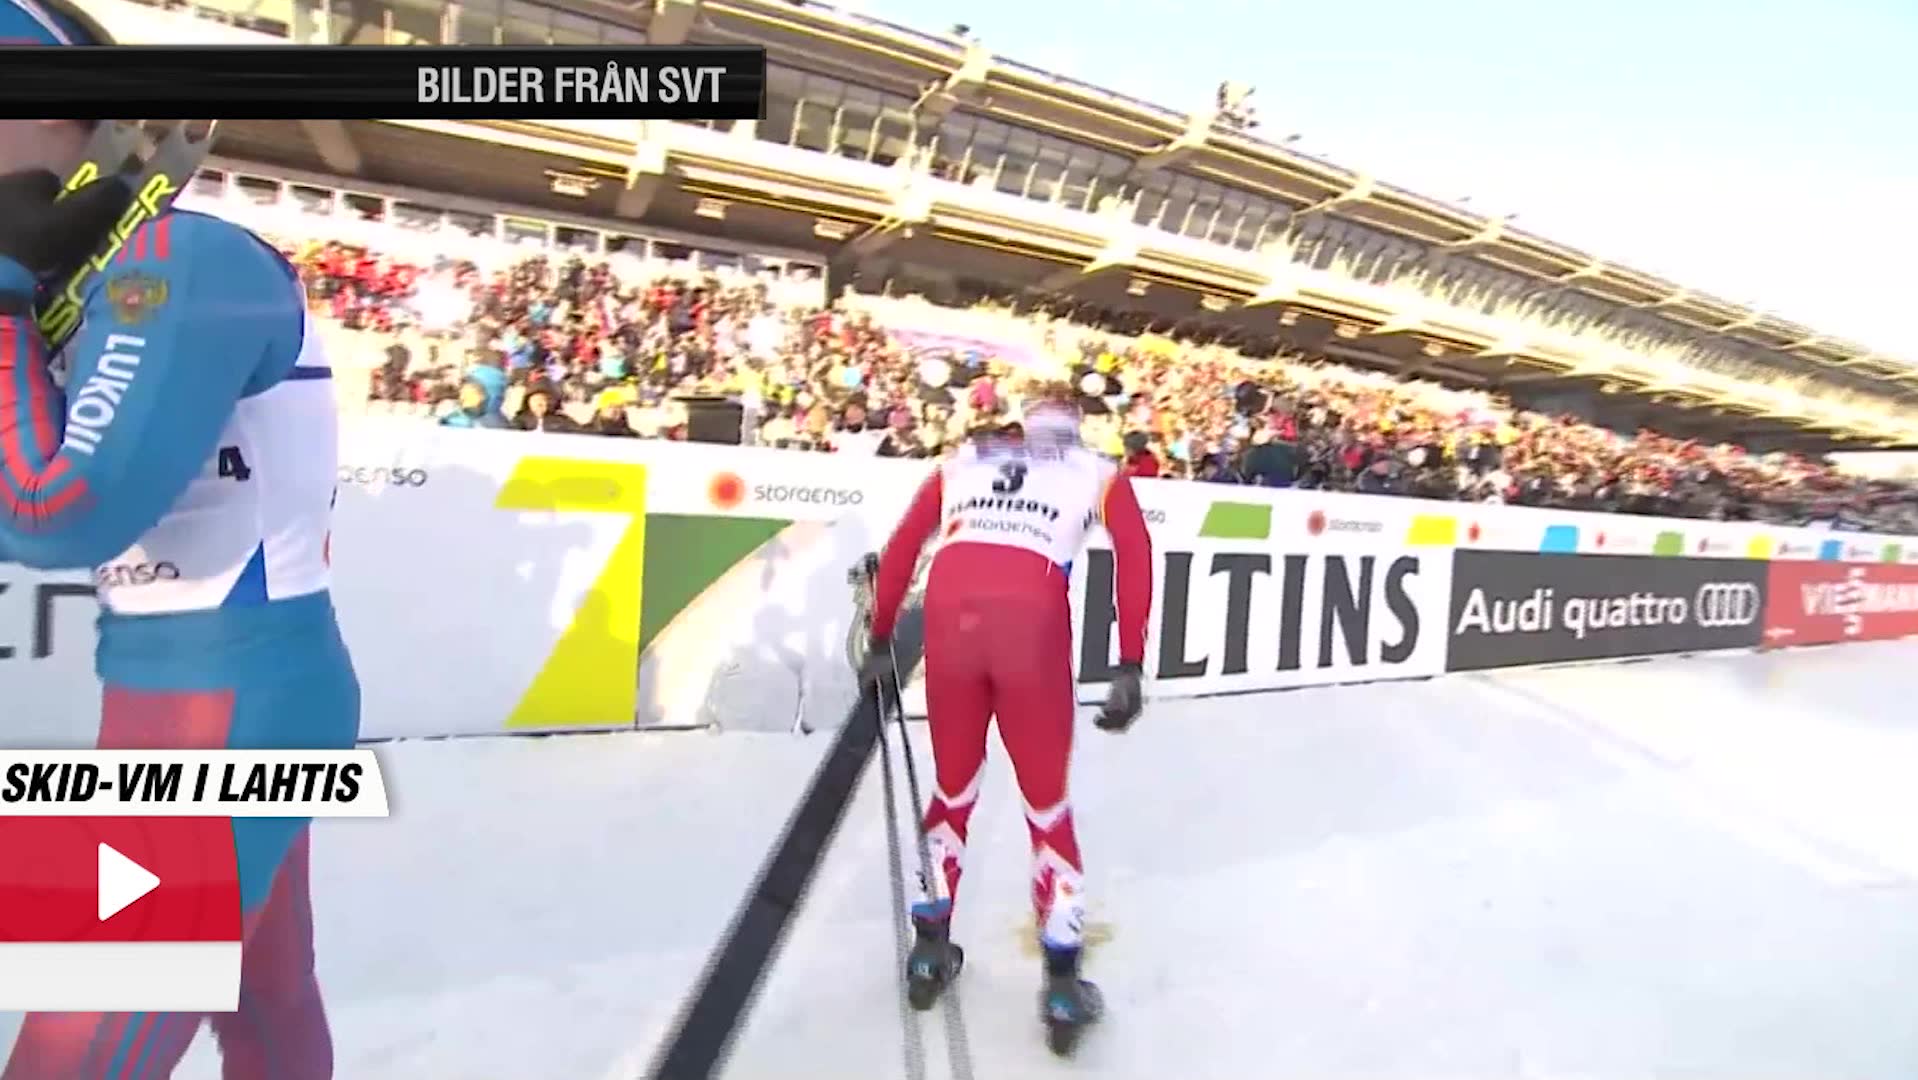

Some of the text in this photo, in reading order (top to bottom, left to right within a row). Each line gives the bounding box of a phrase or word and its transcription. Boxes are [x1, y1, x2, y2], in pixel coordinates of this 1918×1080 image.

[992, 462, 1028, 494] 3
[754, 484, 864, 506] storaenso
[1455, 588, 1688, 640] Audi quattro
